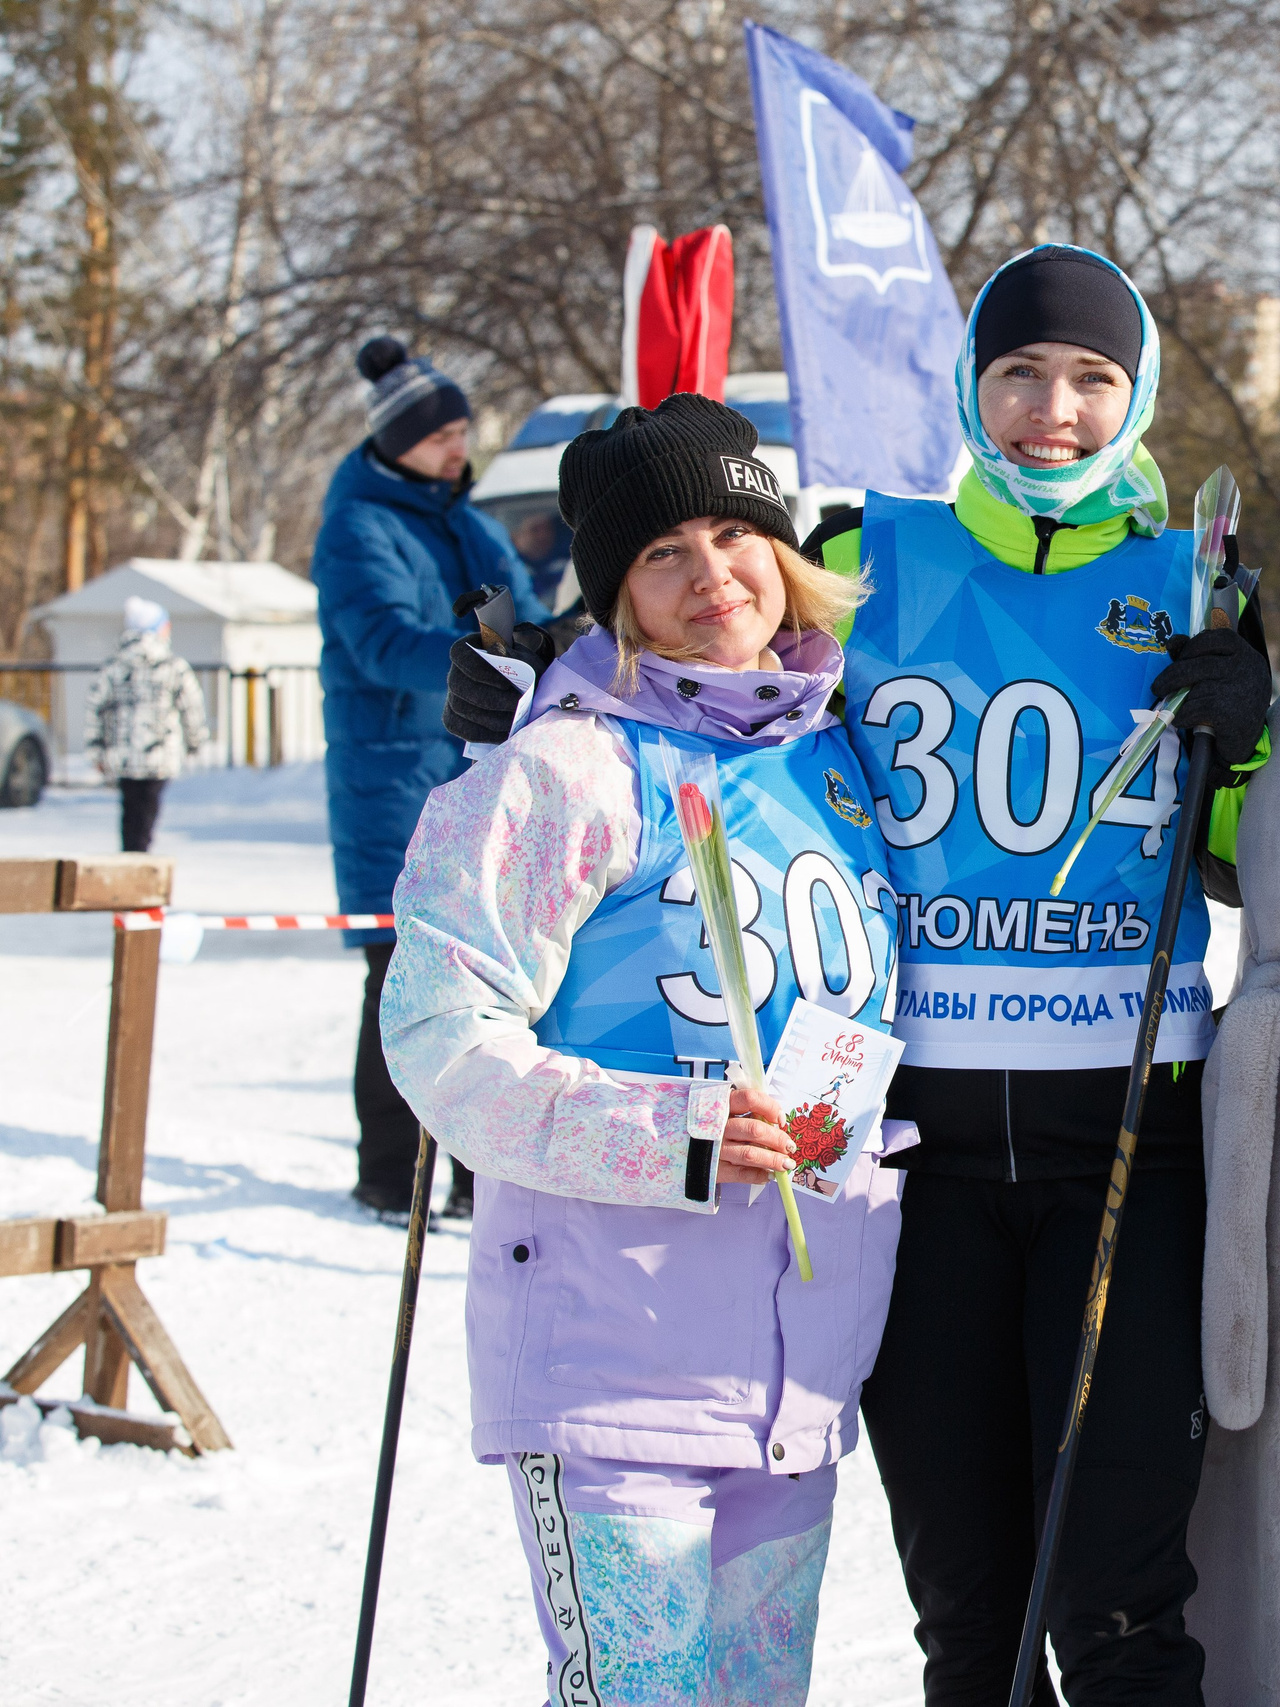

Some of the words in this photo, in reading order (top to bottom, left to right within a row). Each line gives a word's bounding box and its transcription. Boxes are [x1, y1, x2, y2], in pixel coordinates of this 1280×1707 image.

[861, 674, 1181, 860] 304
[988, 993, 1113, 1027] ГОРОДА
[821, 1041, 865, 1074] Марта
[845, 1033, 865, 1053] 8
[530, 1452, 564, 1583] VECTO
